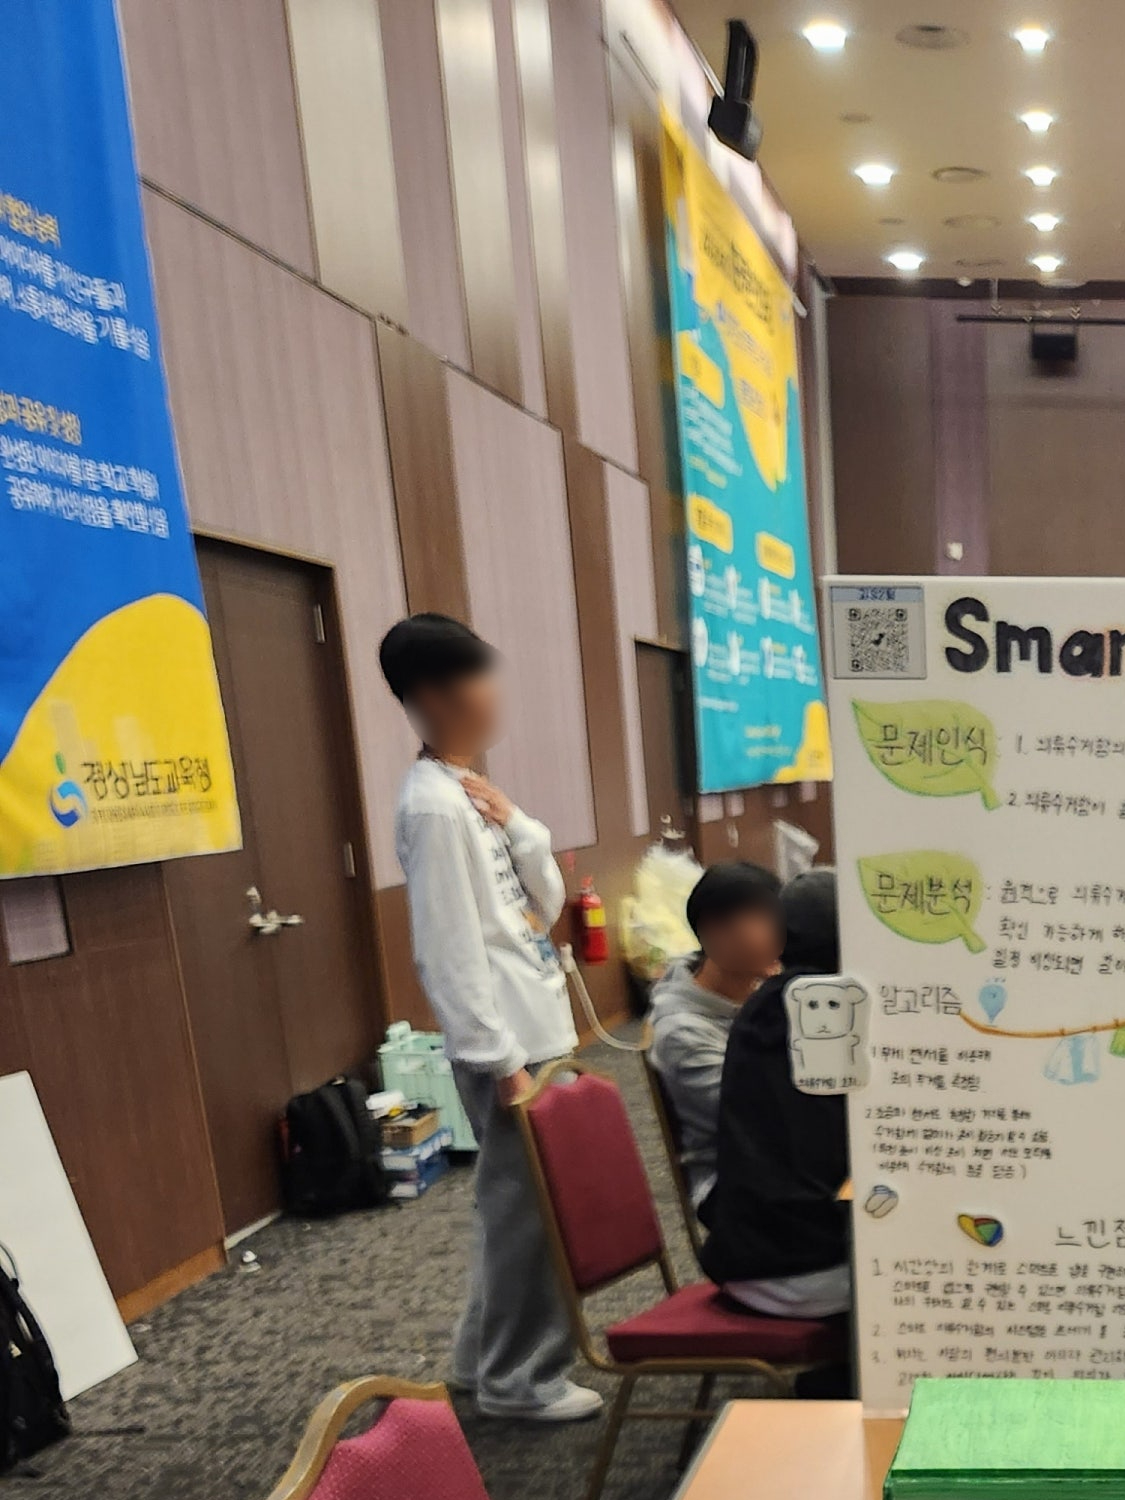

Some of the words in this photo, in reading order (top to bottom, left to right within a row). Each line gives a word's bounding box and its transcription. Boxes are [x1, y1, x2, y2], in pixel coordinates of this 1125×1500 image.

[874, 723, 988, 767] 문제인식
[80, 755, 213, 800] 경상남도교육청
[871, 872, 973, 916] 문제분석
[998, 916, 1029, 942] 확인
[880, 984, 962, 1016] 알고리즘
